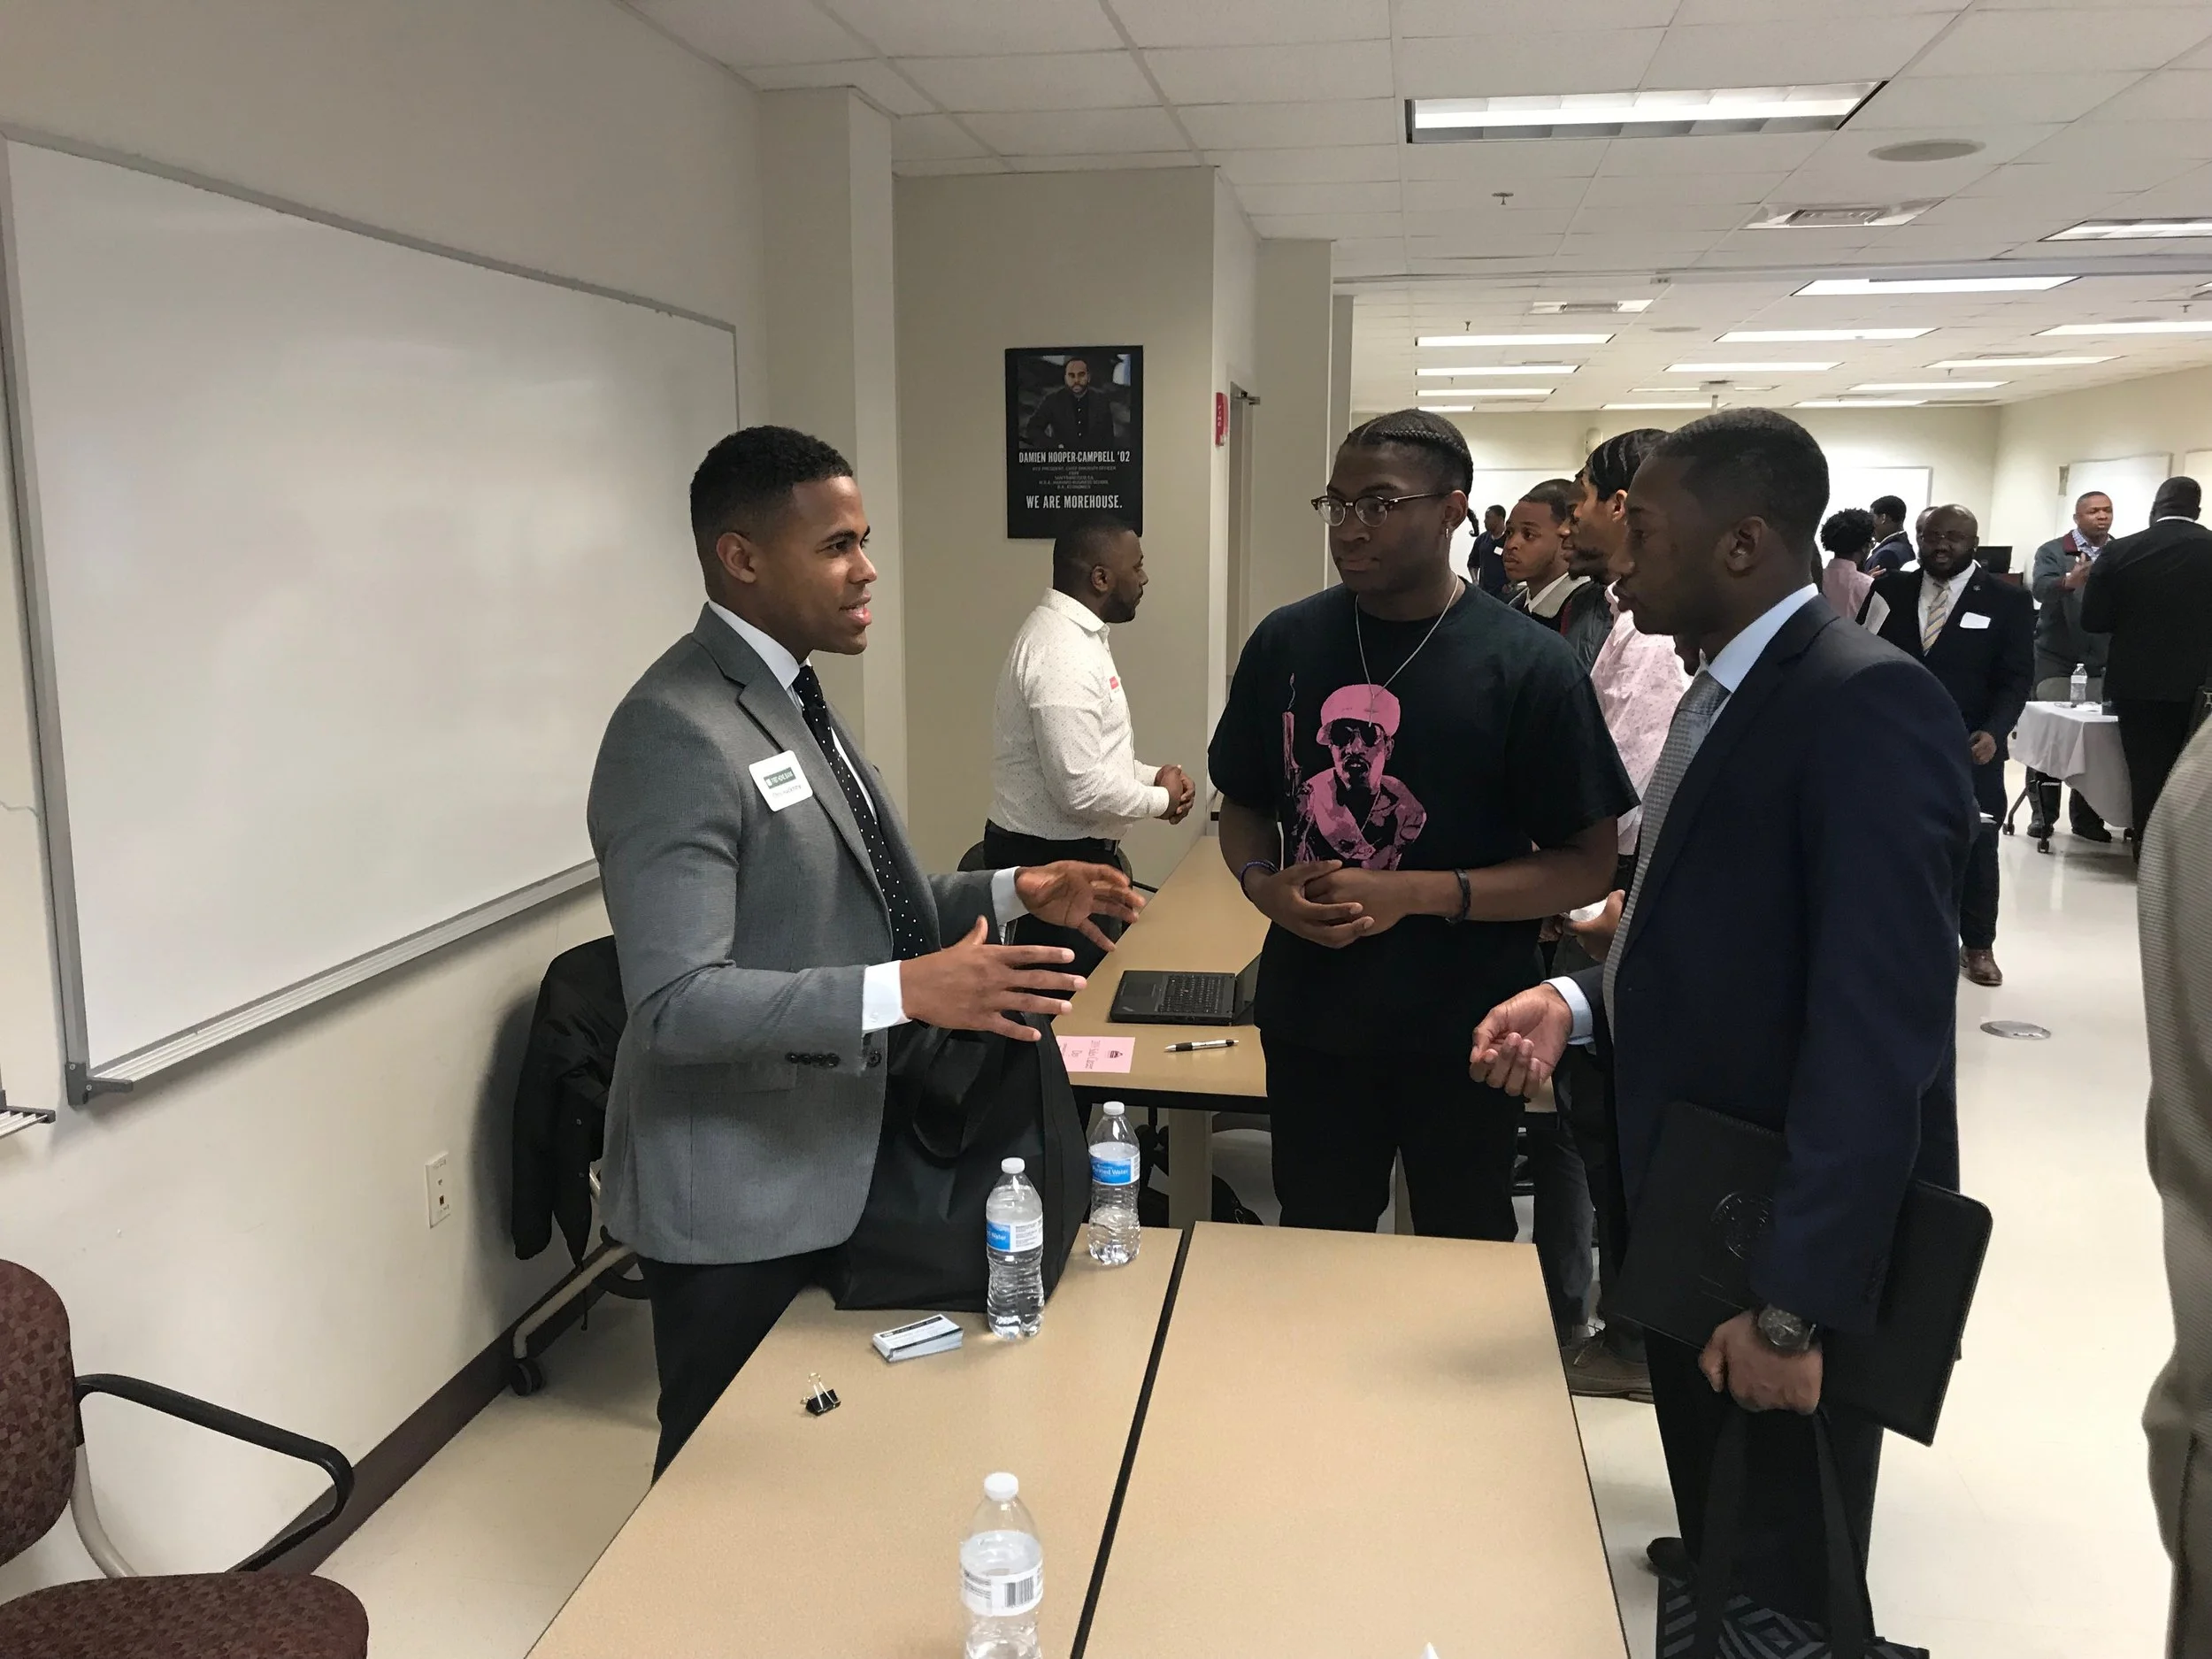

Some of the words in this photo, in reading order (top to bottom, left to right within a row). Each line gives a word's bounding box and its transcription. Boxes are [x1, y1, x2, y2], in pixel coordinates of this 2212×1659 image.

[1018, 451, 1046, 463] DAMIEN
[1048, 450, 1115, 462] HOOPER-CAMPBELL
[1117, 450, 1130, 462] '02
[1026, 495, 1040, 509] WE
[1043, 495, 1061, 509] ARE
[1064, 495, 1123, 509] MOREHOUSE.
